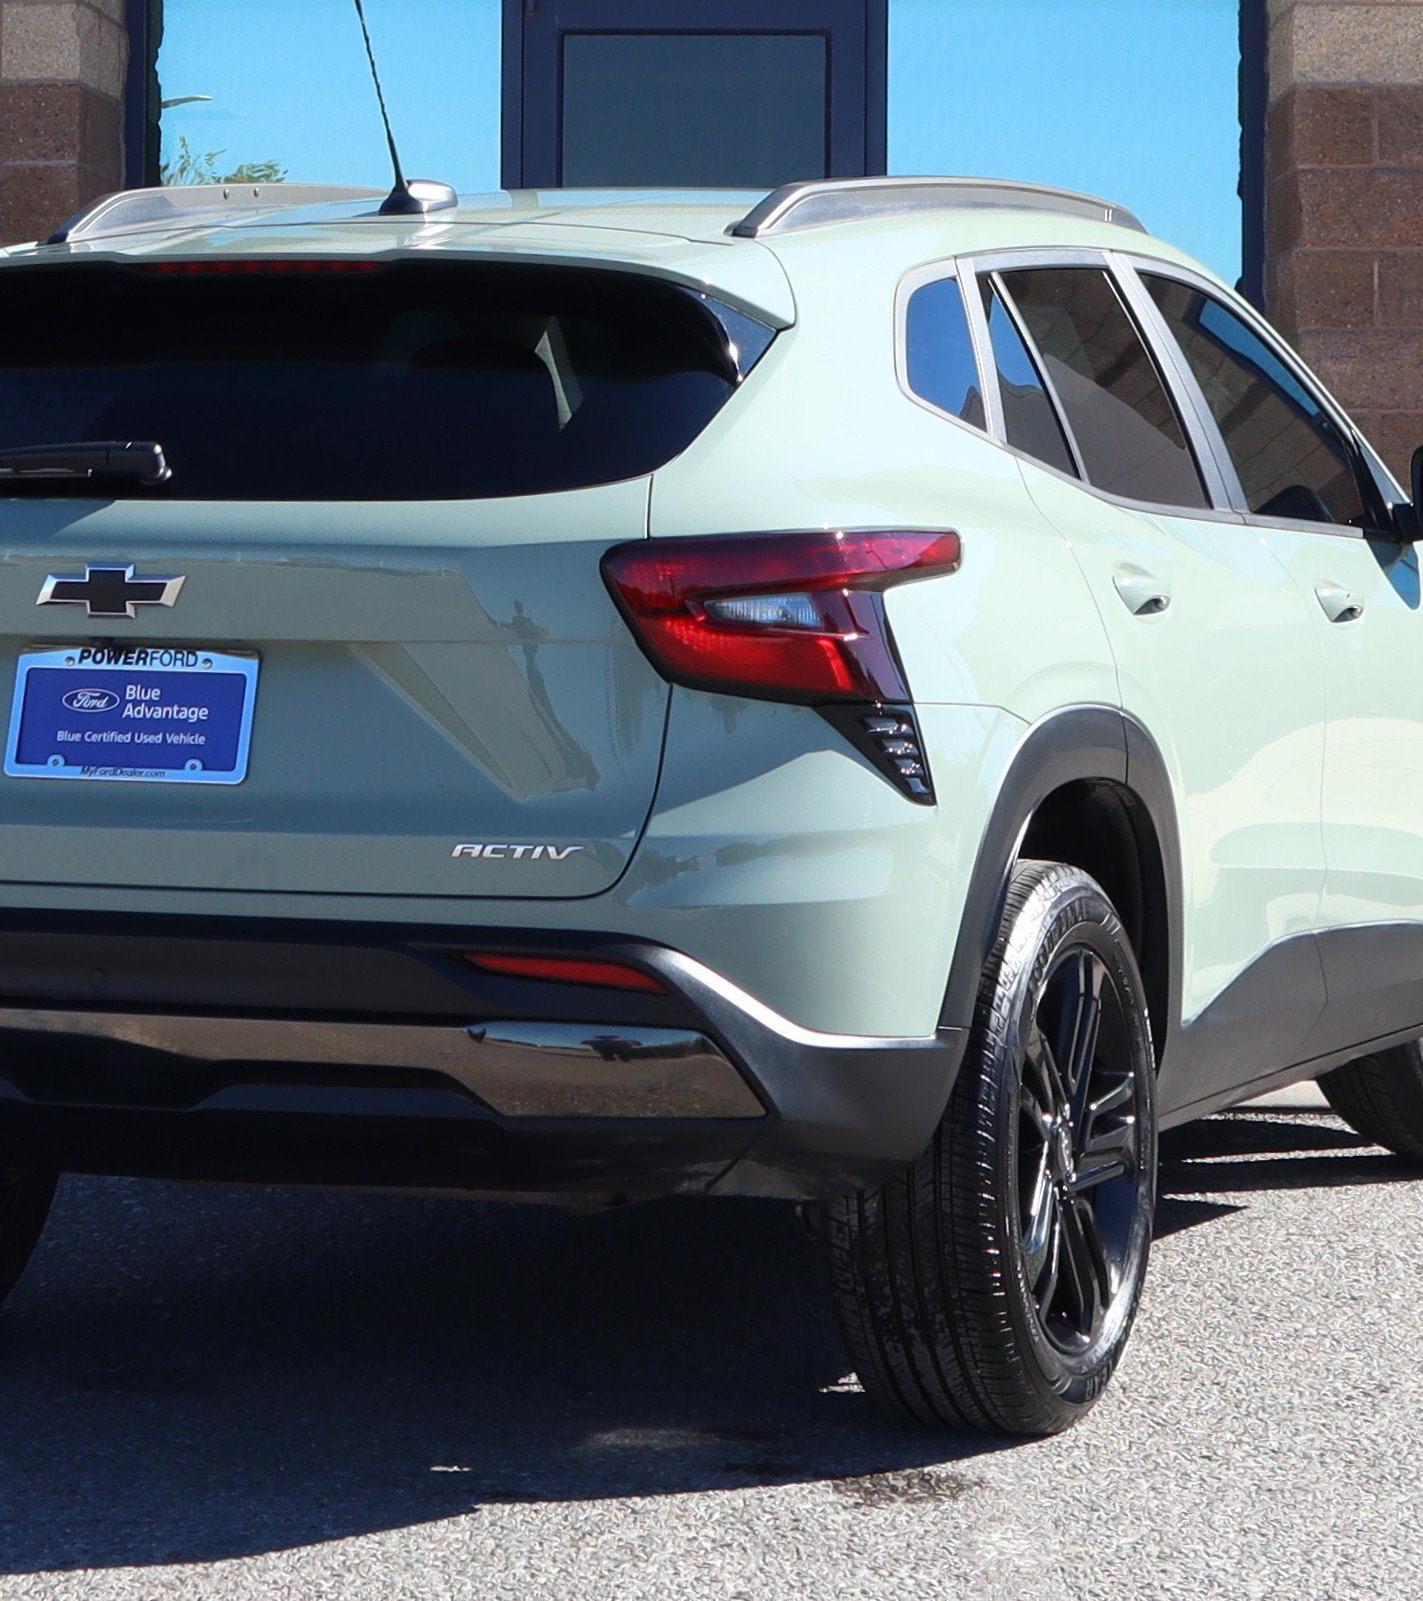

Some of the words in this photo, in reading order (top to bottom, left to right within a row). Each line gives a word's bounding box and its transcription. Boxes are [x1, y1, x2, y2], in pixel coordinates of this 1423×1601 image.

[72, 692, 108, 709] Ford
[125, 685, 161, 701] Blue
[122, 703, 209, 723] Advantage
[56, 730, 81, 743] Blue
[84, 731, 131, 744] Certified
[134, 732, 162, 744] Used
[166, 733, 206, 745] Vehicle
[451, 843, 585, 860] ACTIV
